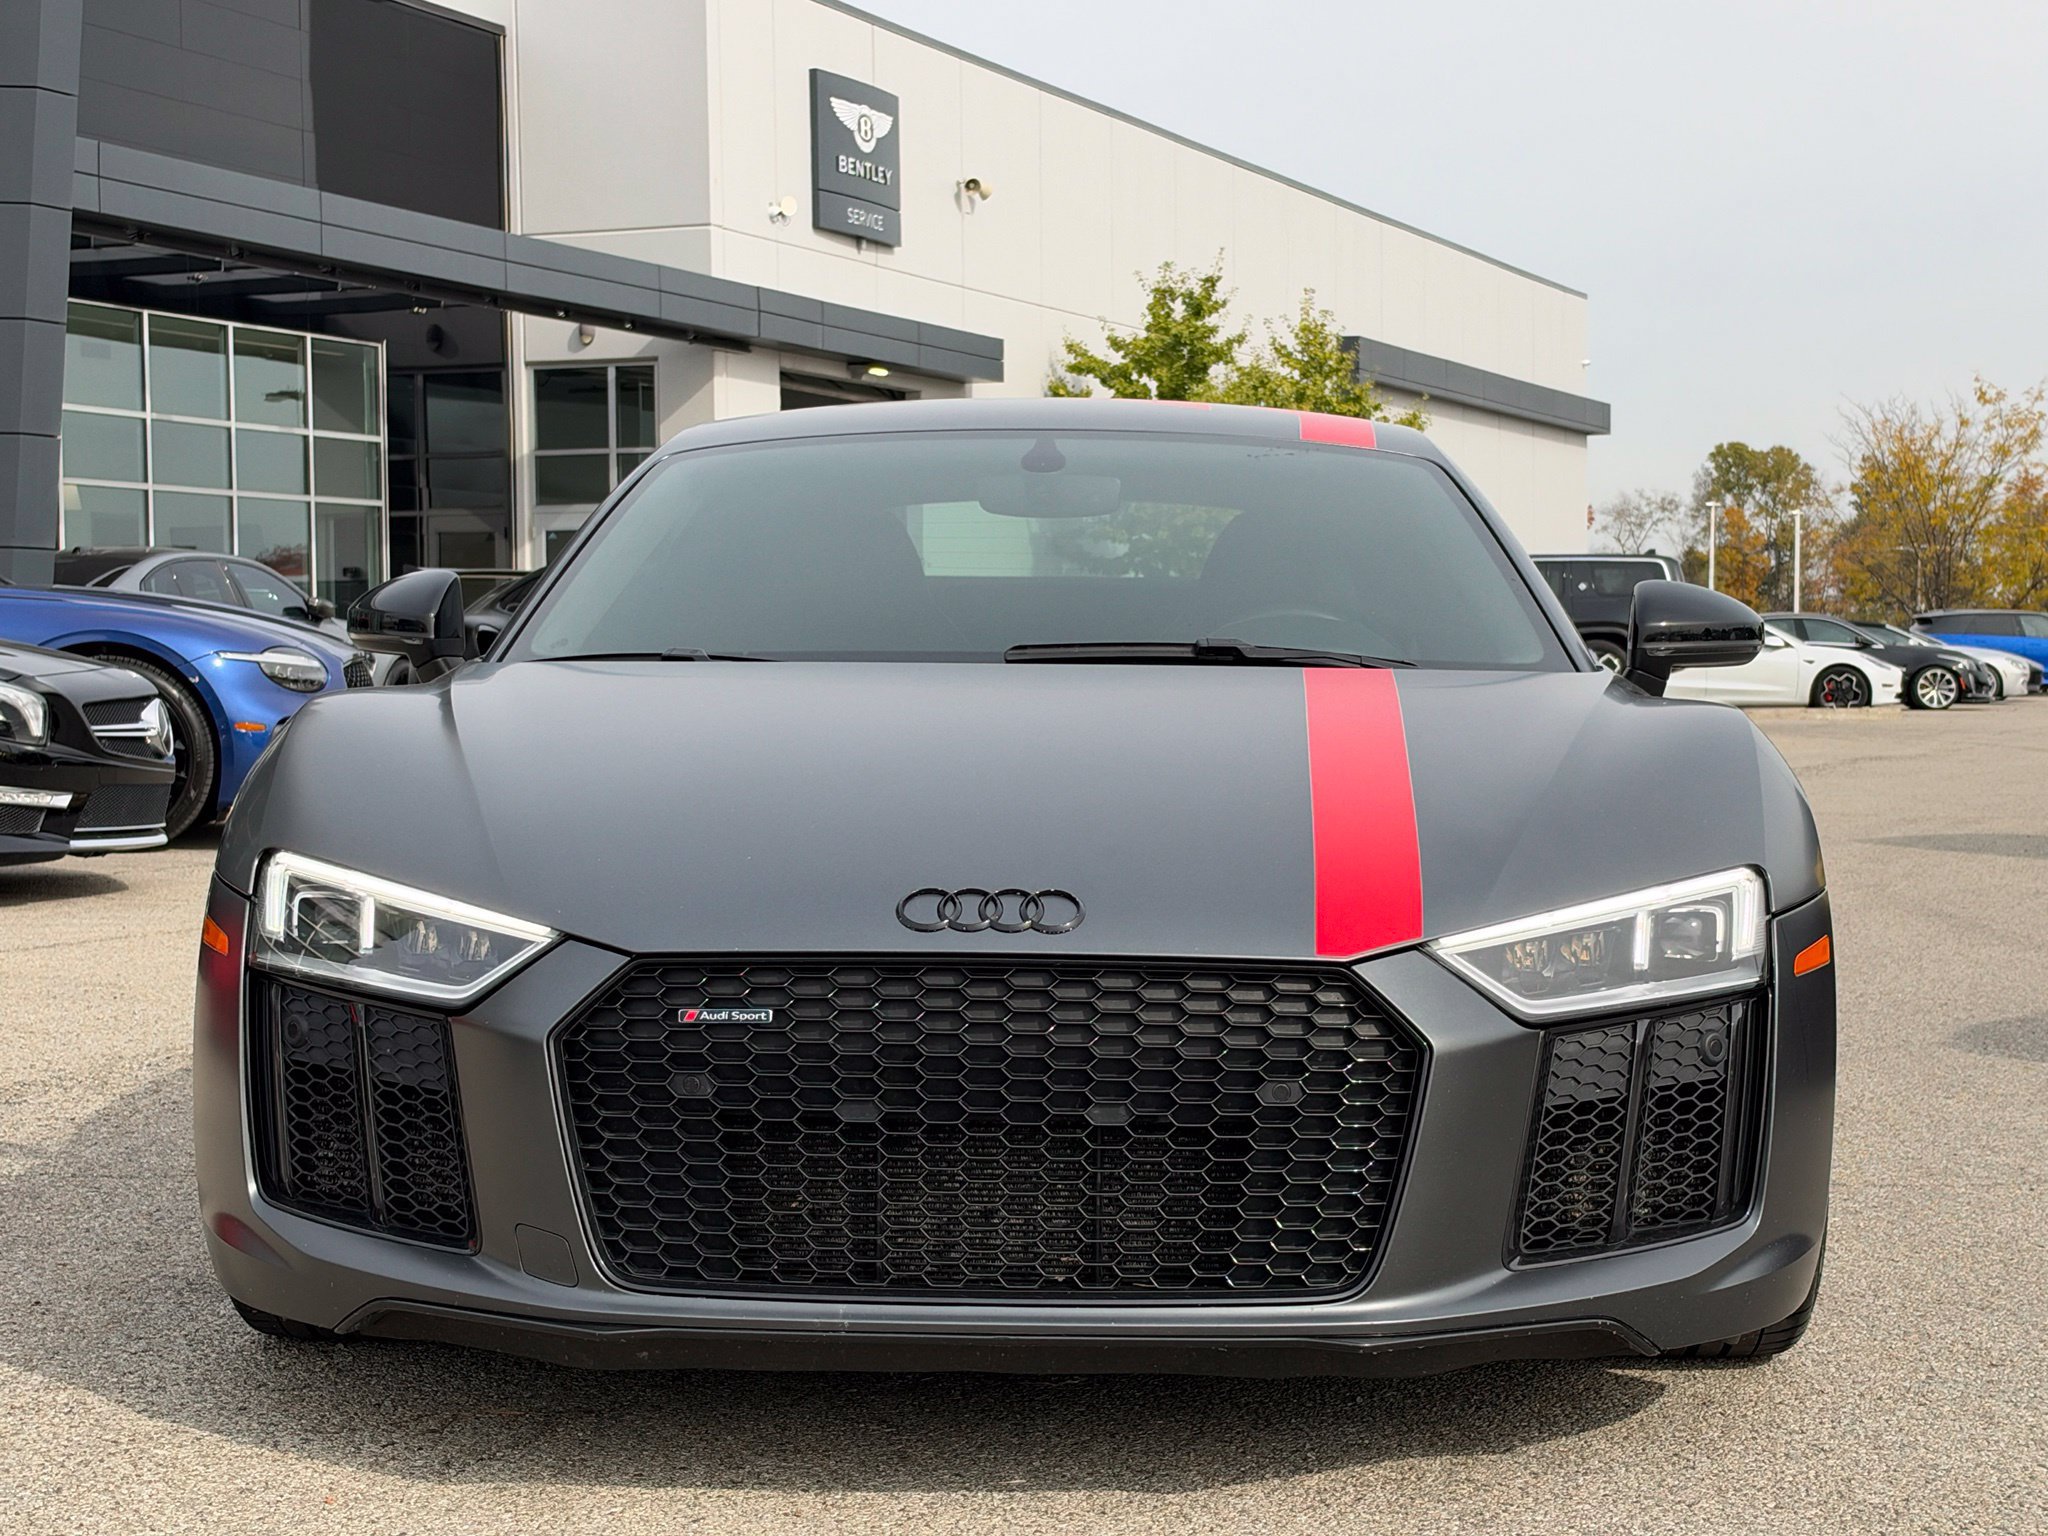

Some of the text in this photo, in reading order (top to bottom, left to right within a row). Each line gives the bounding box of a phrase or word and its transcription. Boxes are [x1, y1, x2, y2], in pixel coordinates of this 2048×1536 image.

[860, 116, 872, 140] B
[838, 155, 893, 185] BENTLEY
[847, 208, 885, 231] SERVICE
[700, 1011, 767, 1023] Audi Sport
